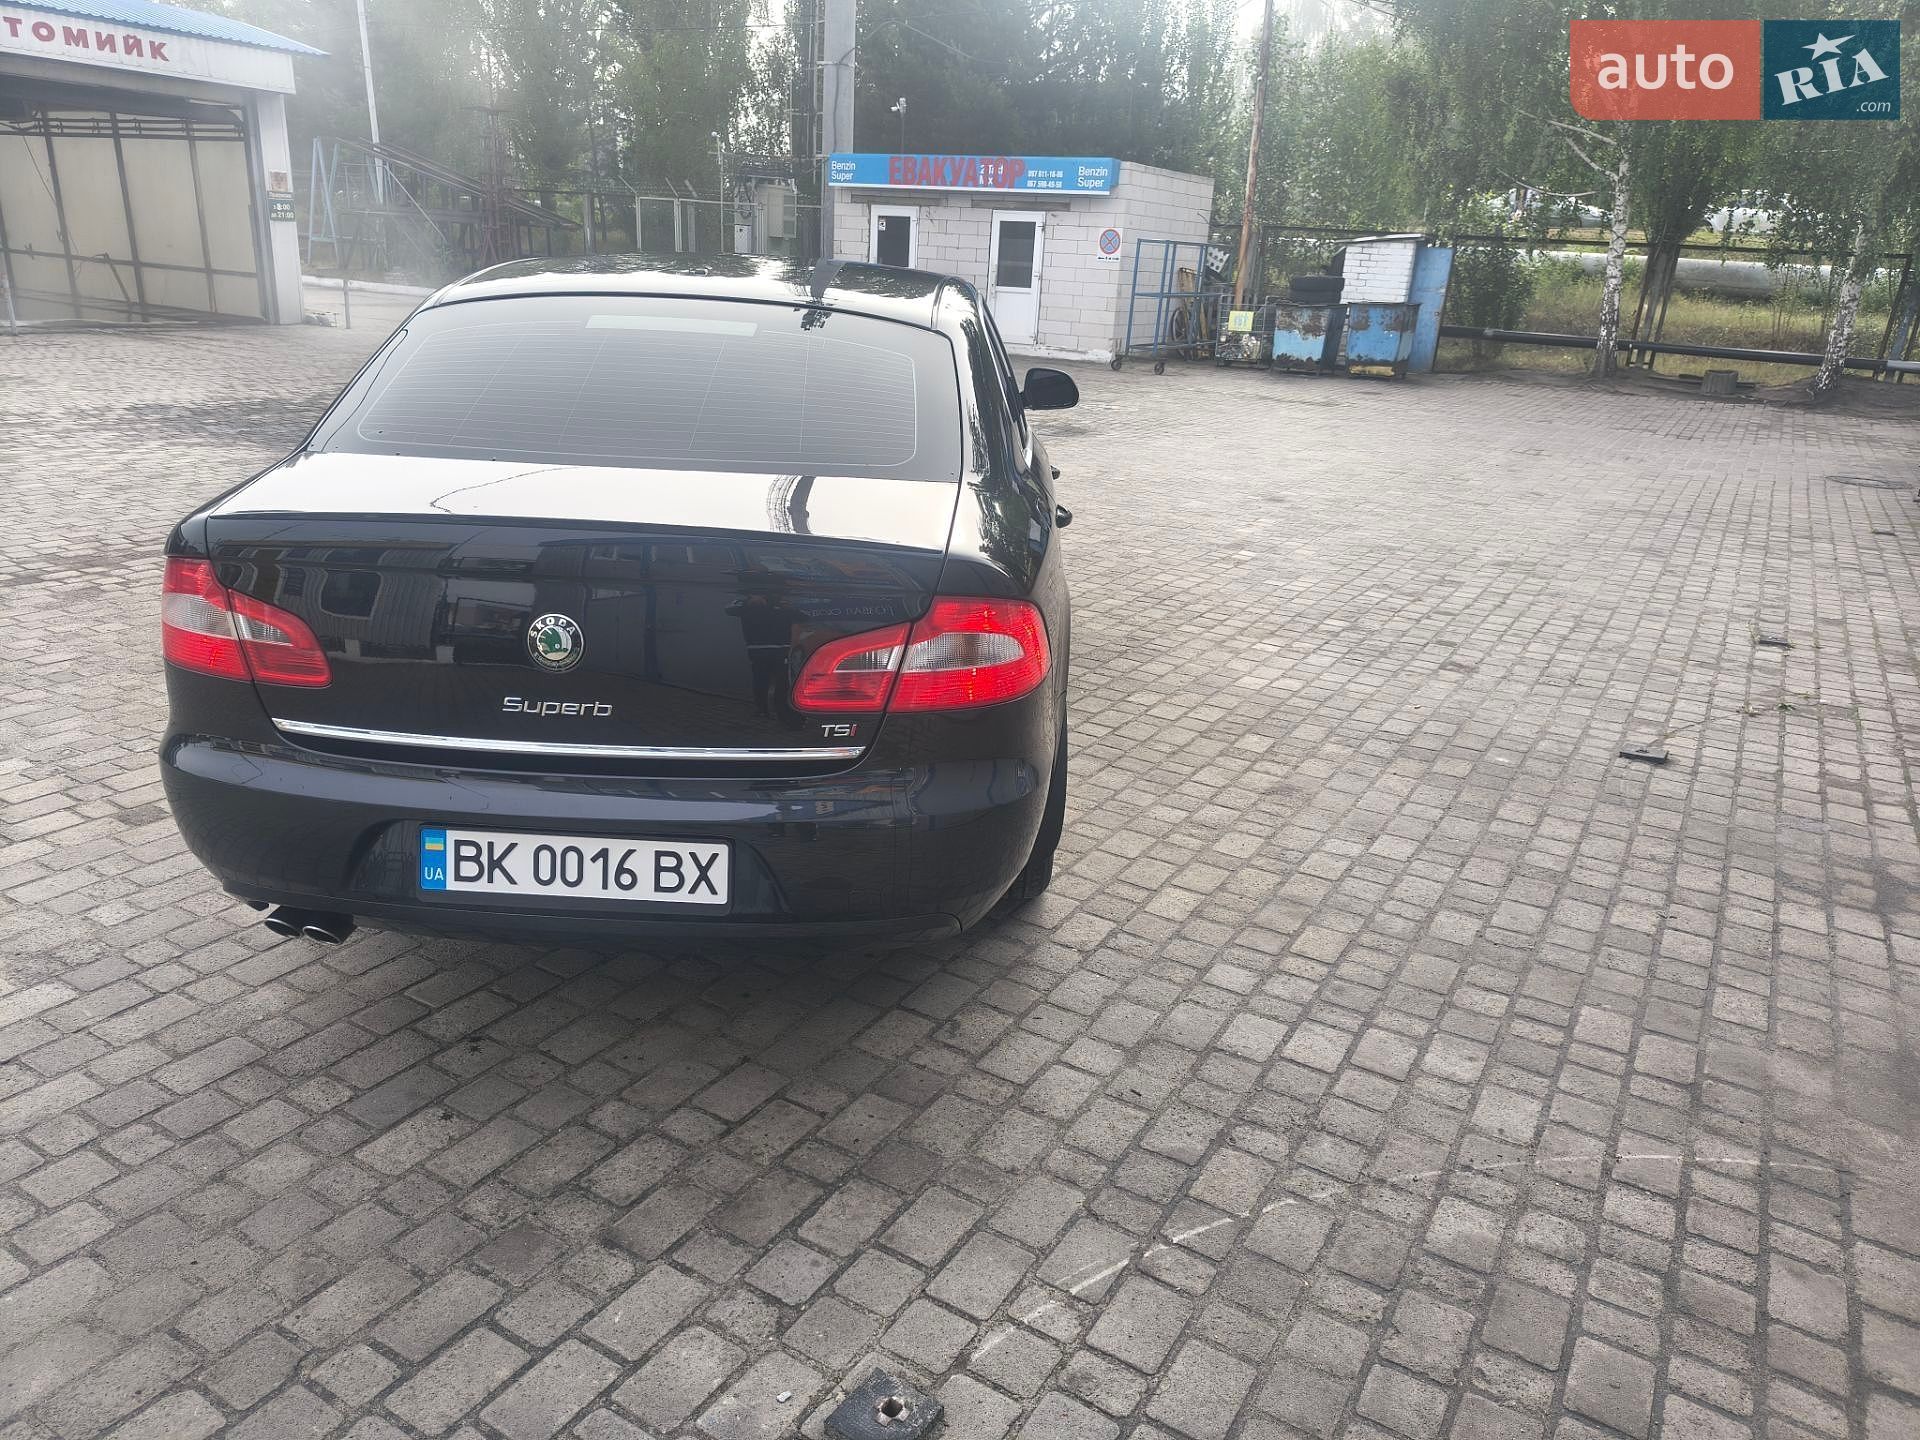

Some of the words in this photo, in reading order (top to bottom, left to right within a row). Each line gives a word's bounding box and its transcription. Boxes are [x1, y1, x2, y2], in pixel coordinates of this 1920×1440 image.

[2, 16, 169, 62] ТОМИЙК
[831, 160, 856, 171] Benzin
[889, 154, 1026, 188] ЕВАКУАТОР
[1077, 165, 1108, 177] Benzin
[831, 170, 854, 182] Super
[1077, 176, 1105, 189] Super
[502, 696, 613, 717] Superb
[424, 867, 444, 881] UA
[453, 839, 519, 886] BK
[532, 843, 638, 892] 0016
[653, 849, 720, 896] BX
